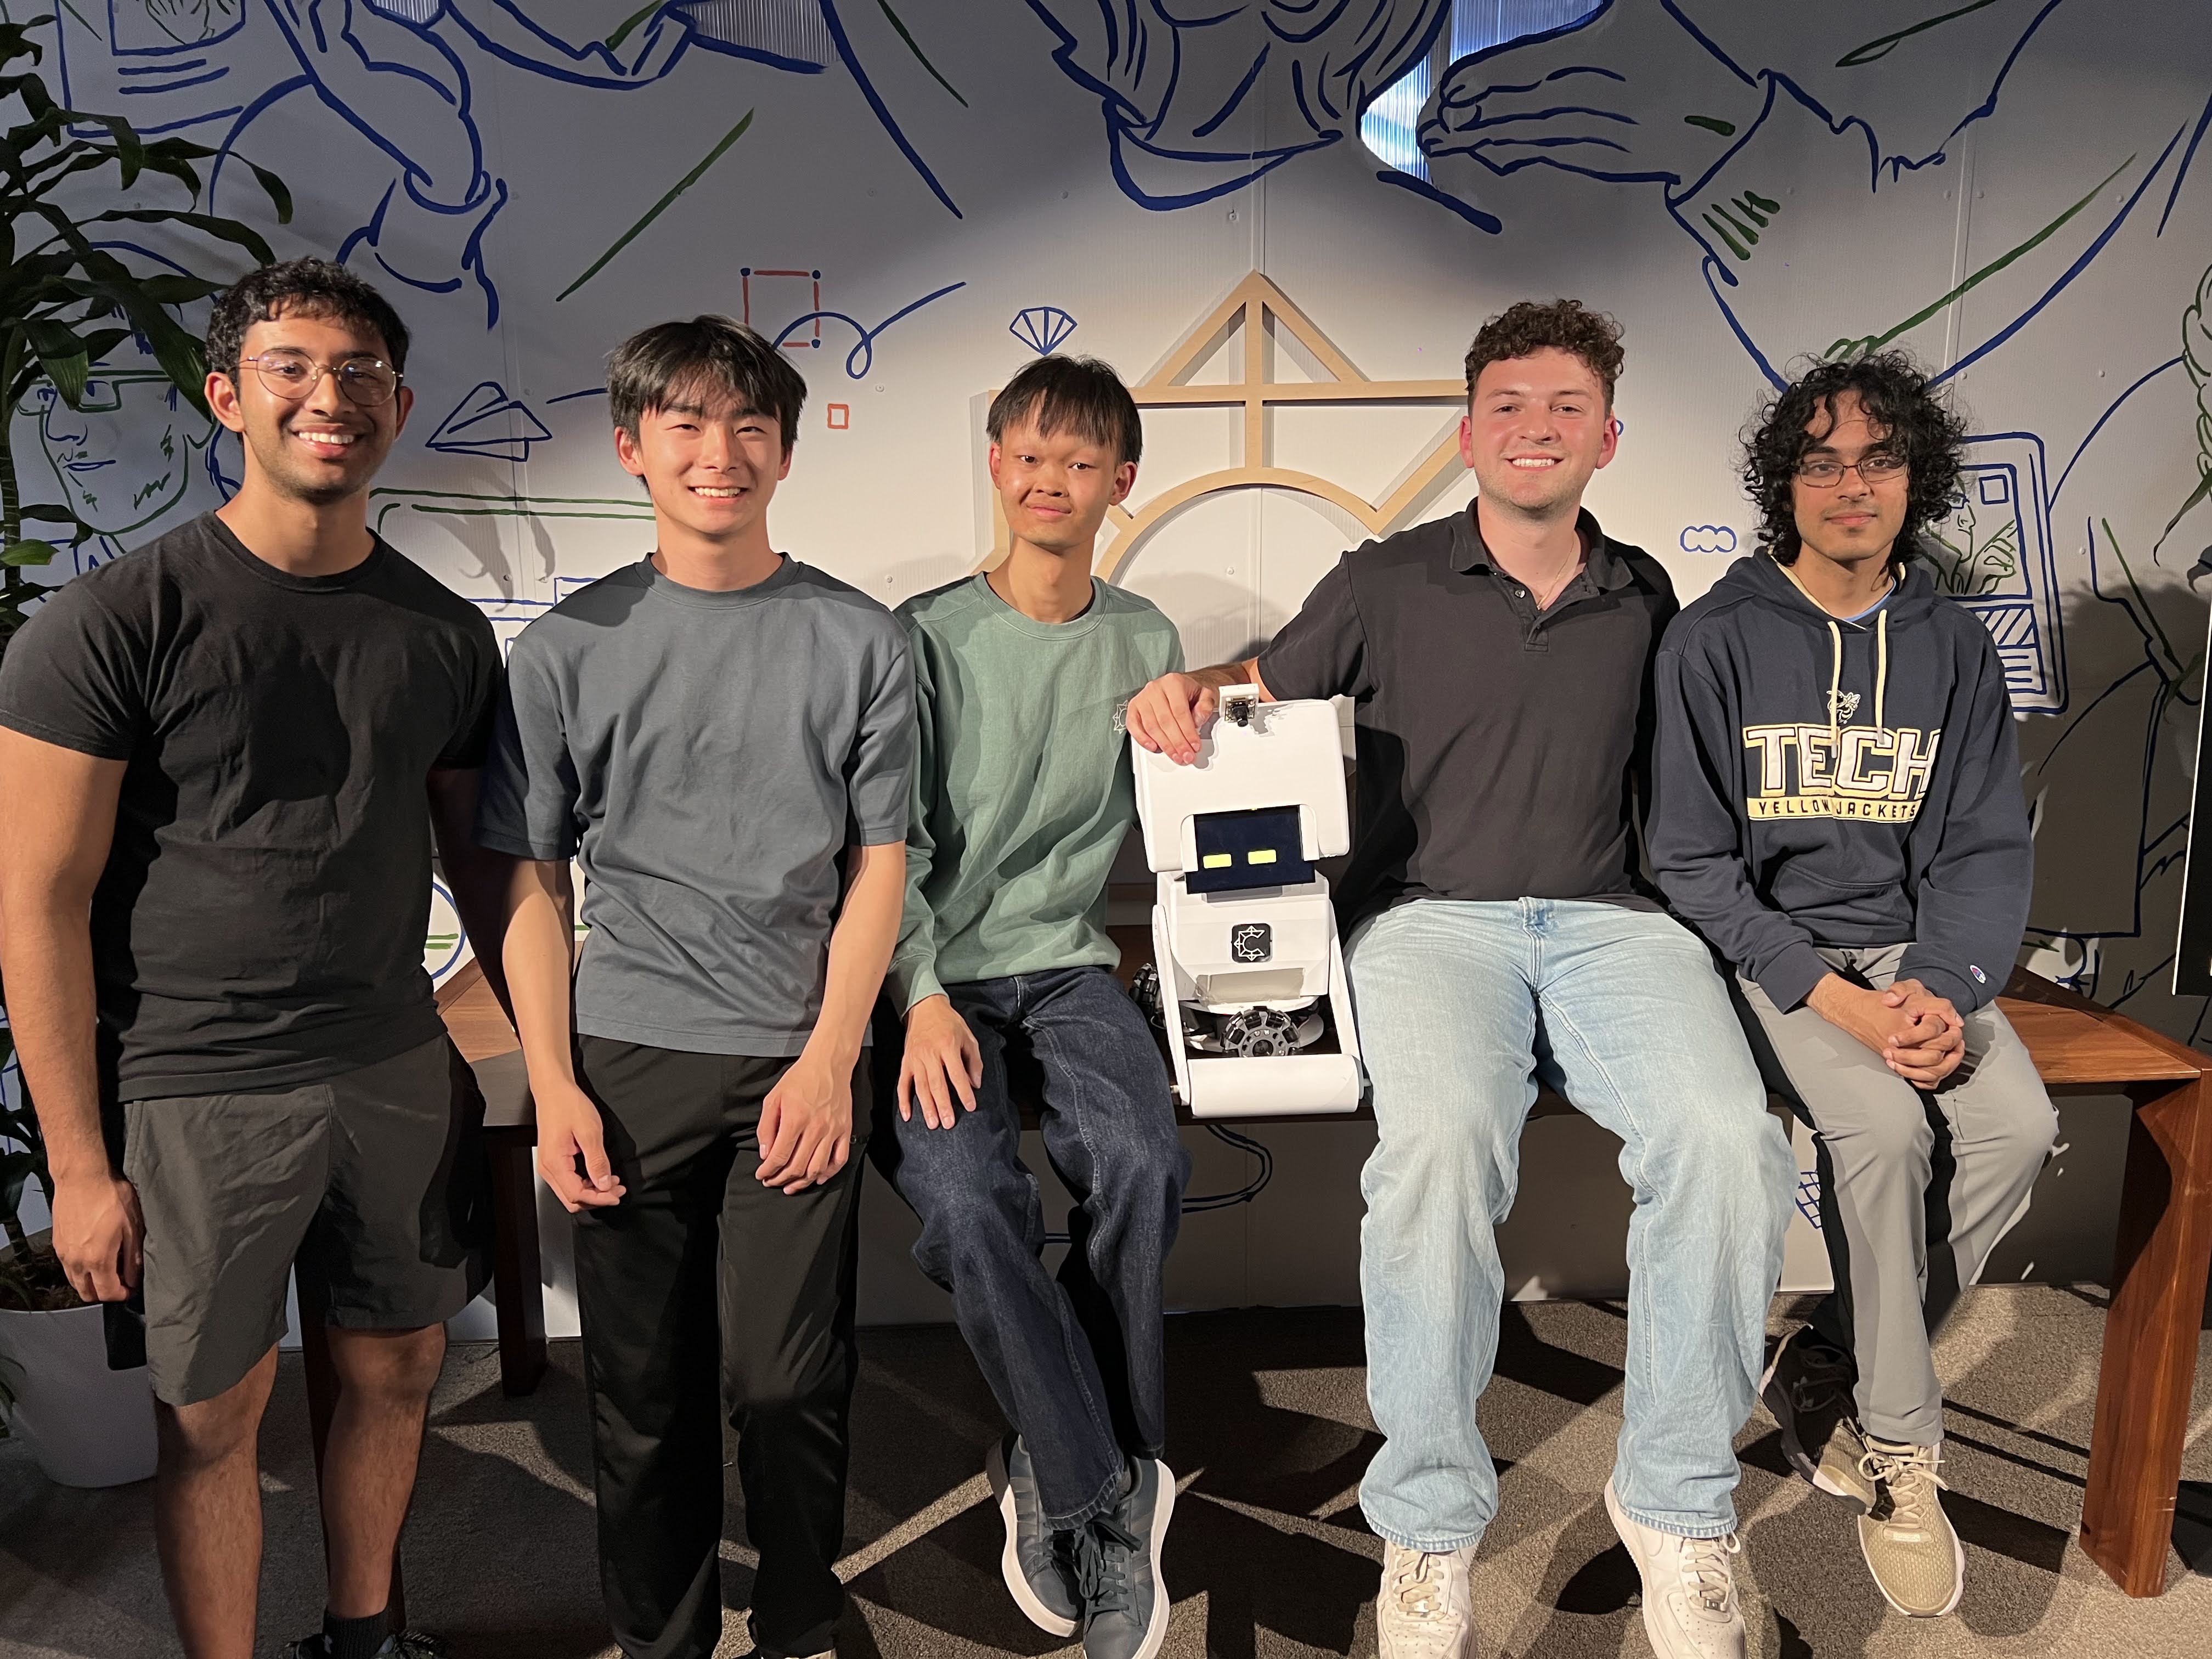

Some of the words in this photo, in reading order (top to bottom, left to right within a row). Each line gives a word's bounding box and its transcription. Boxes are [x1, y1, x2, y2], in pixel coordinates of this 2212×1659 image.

[1742, 723, 1941, 800] TECH
[1758, 799, 1831, 815] YELLOW
[1836, 801, 1916, 818] JACKETS
